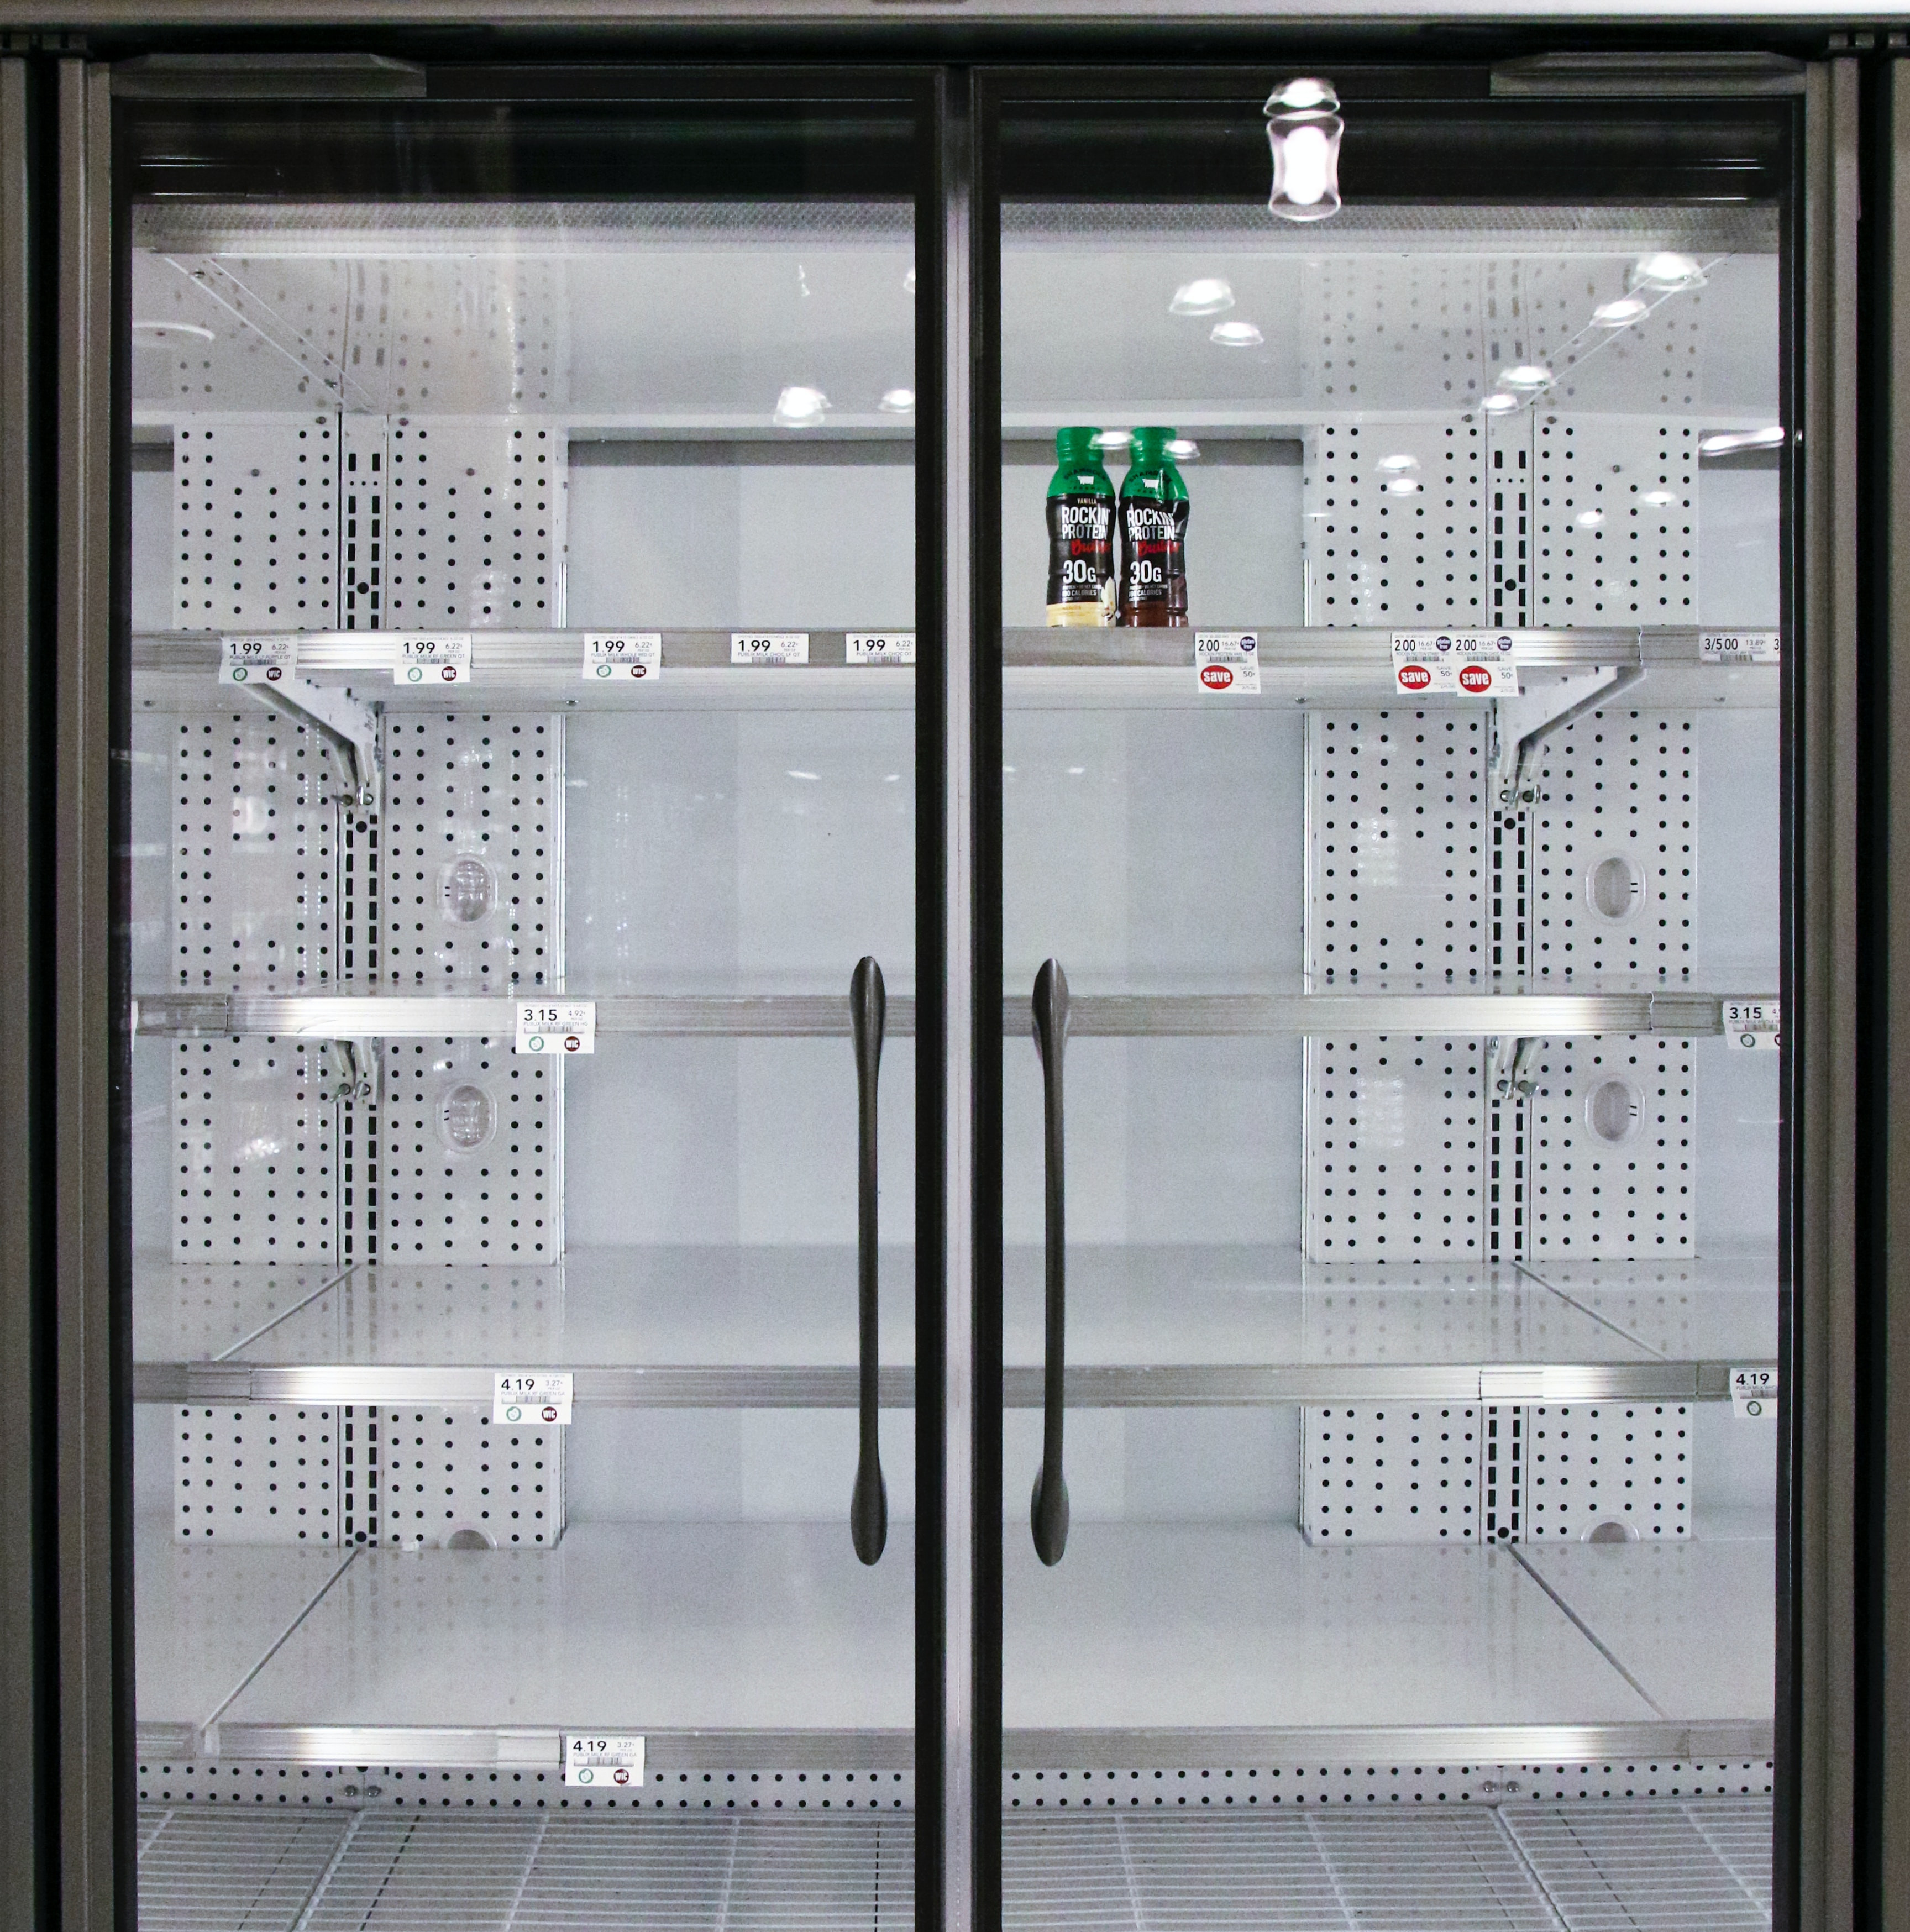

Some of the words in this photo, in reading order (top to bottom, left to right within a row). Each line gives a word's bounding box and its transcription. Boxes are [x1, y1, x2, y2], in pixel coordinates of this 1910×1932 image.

[1062, 524, 1108, 539] PROTEIN
[1127, 526, 1175, 542] PROTEIN
[1062, 559, 1096, 584] 30G
[1130, 560, 1162, 584] 30G
[230, 643, 262, 655] 1.99
[403, 642, 435, 654] 1.99
[592, 641, 625, 652] 1.99
[738, 640, 770, 652] 1.99
[853, 639, 885, 651] 1.99
[1198, 639, 1219, 652] 2.00
[1394, 639, 1415, 652] 2.00
[1456, 639, 1477, 651] 2.00
[1704, 638, 1738, 650] 3/5.00
[268, 670, 280, 678] WIC
[443, 670, 455, 678] WIC
[1203, 671, 1231, 683] save
[1400, 671, 1429, 683] save
[1461, 673, 1489, 685] save
[524, 1009, 557, 1021] 3.15
[1729, 1007, 1761, 1019] 3.15
[565, 1040, 579, 1048] WIC
[501, 1379, 534, 1390] 4.19
[1736, 1373, 1770, 1385] 4.19
[543, 1410, 556, 1419] WIC
[573, 1740, 606, 1751] 4.19
[615, 1772, 628, 1781] WIC
